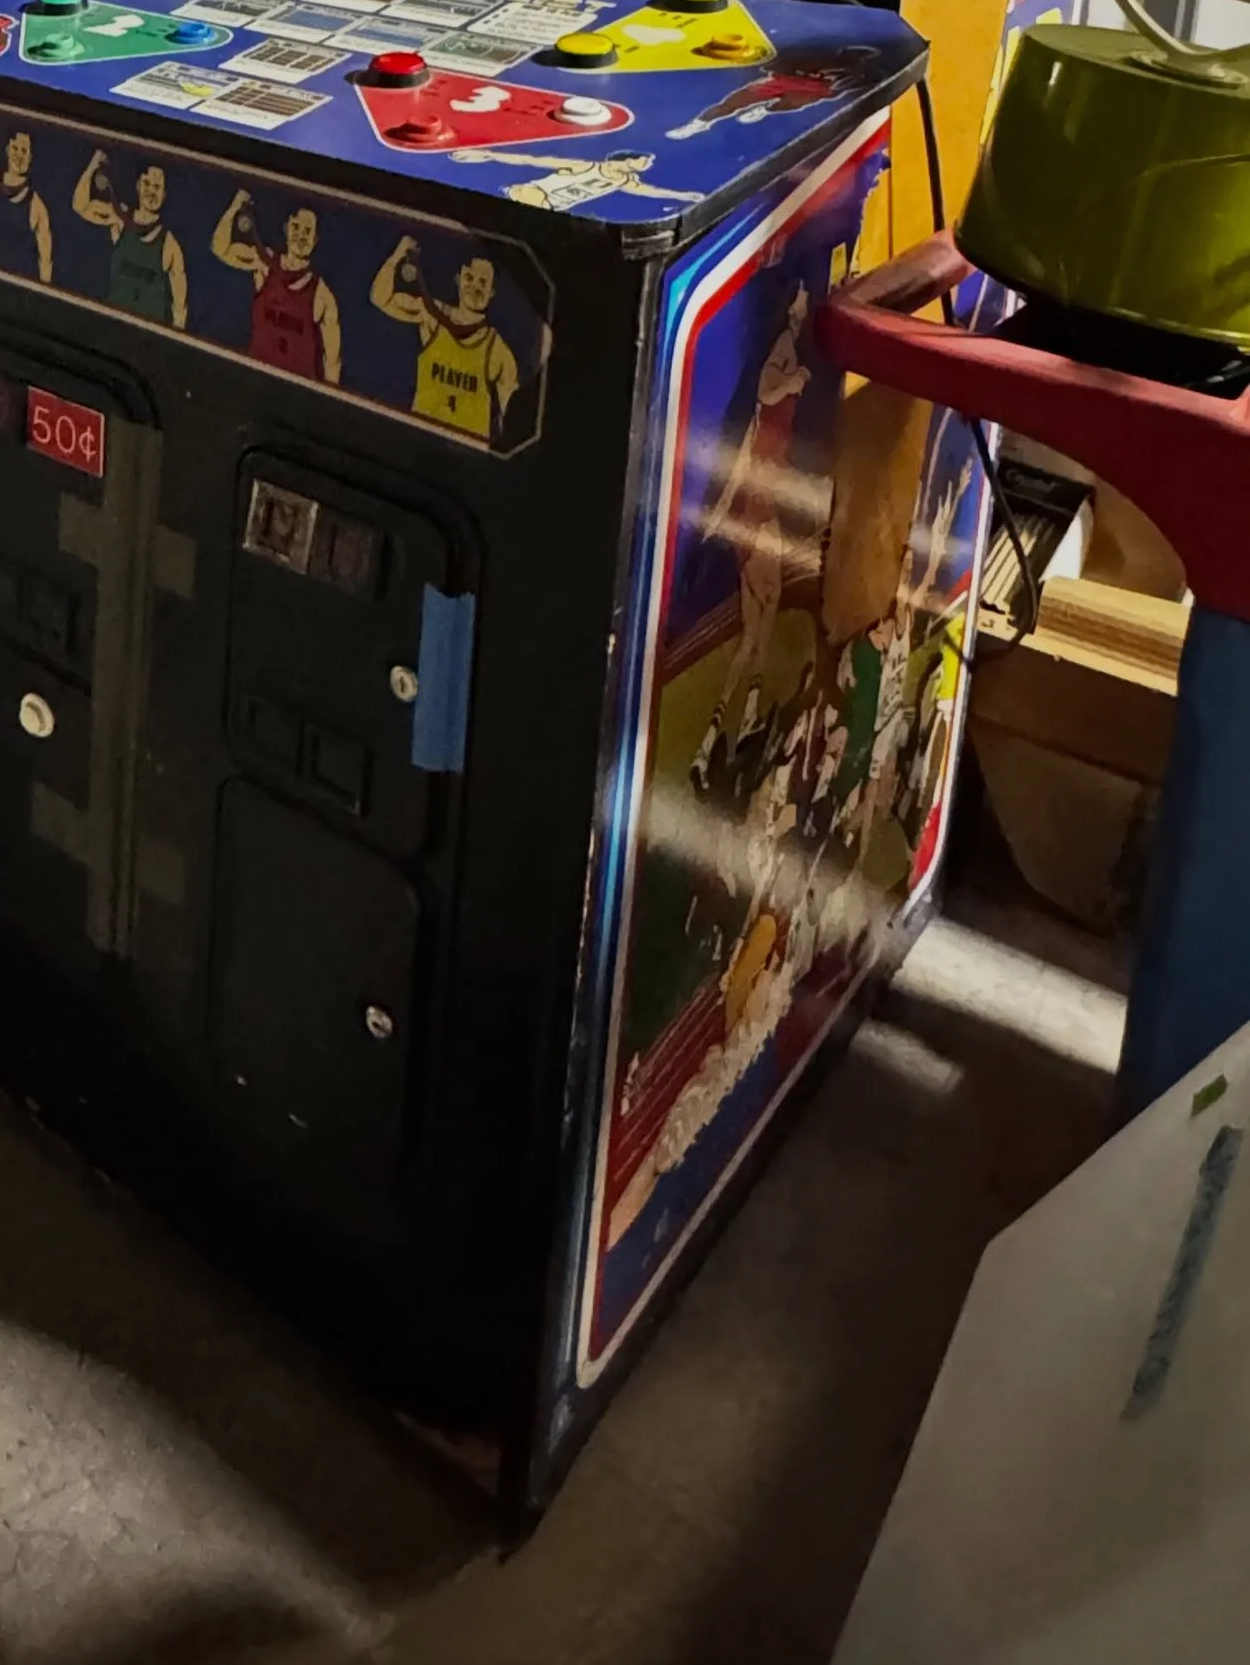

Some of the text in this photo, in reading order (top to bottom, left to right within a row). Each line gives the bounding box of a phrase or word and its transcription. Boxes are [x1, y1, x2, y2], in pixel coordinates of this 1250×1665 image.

[449, 85, 511, 113] 3
[431, 361, 478, 393] PLAYER
[32, 403, 97, 463] 50¢
